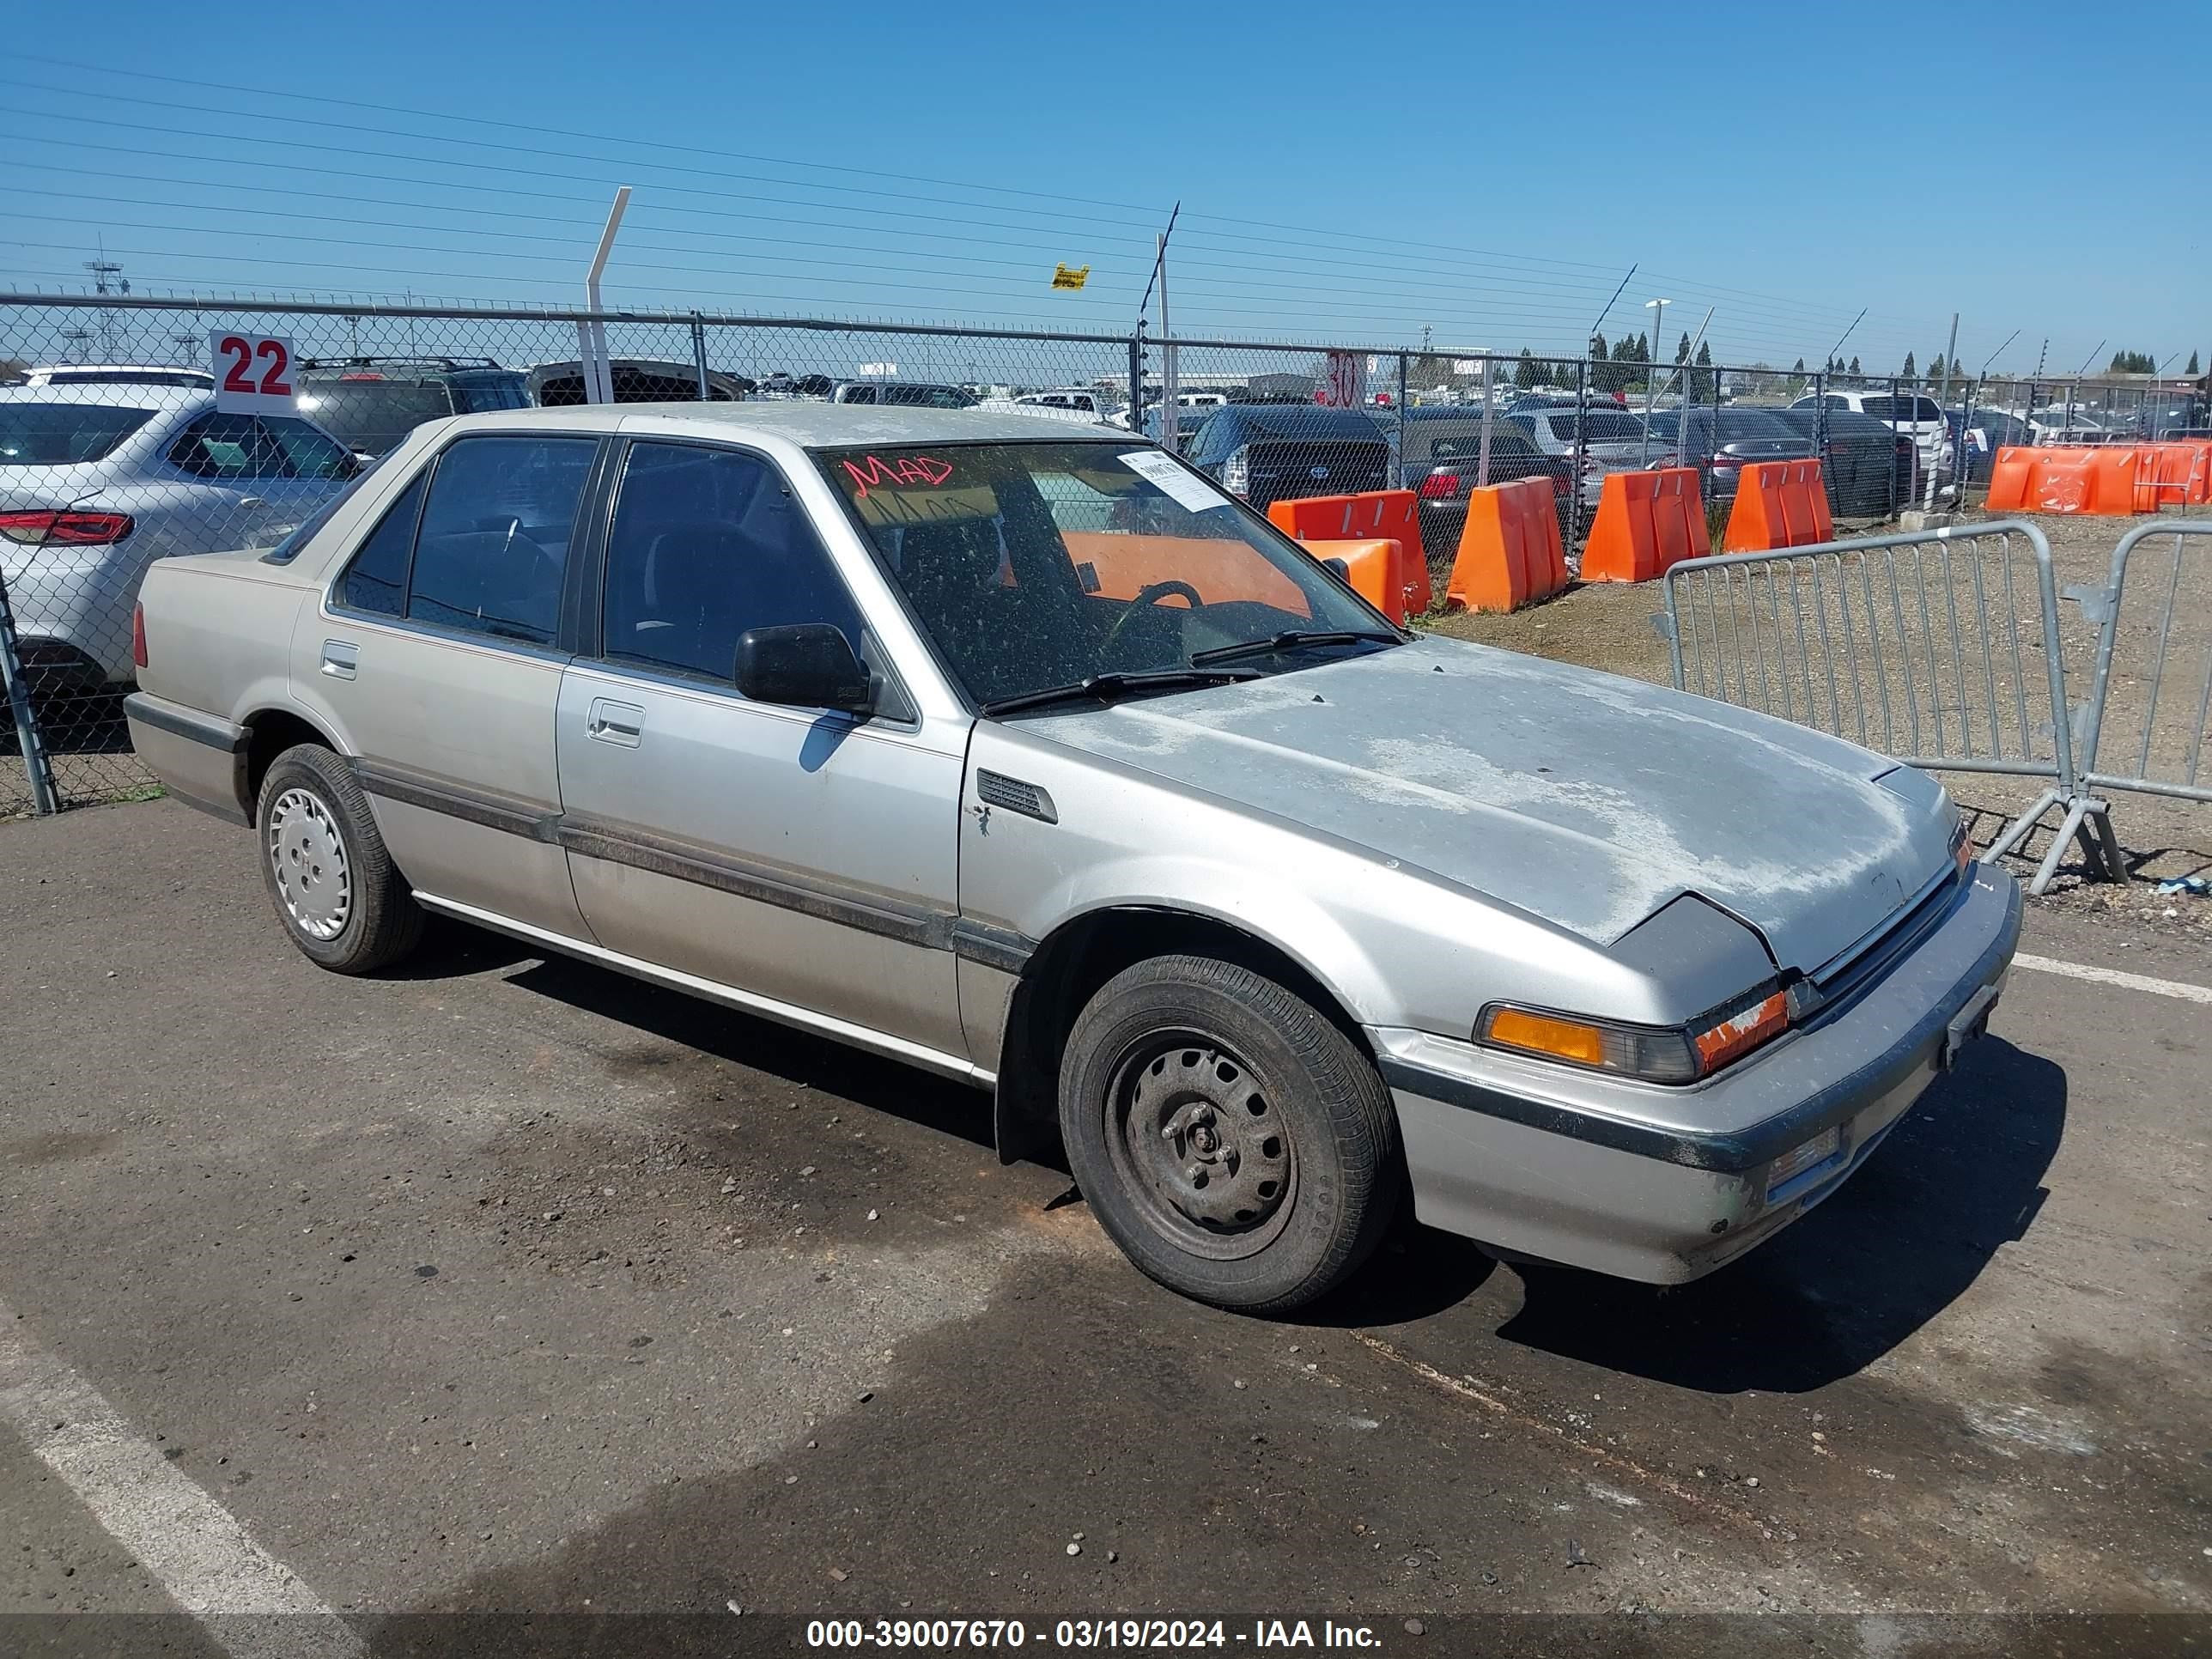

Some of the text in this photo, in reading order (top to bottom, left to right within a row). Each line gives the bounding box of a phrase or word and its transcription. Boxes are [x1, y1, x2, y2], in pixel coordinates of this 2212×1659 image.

[220, 337, 292, 396] 22
[1327, 351, 1354, 408] 30
[843, 455, 954, 498] MAD
